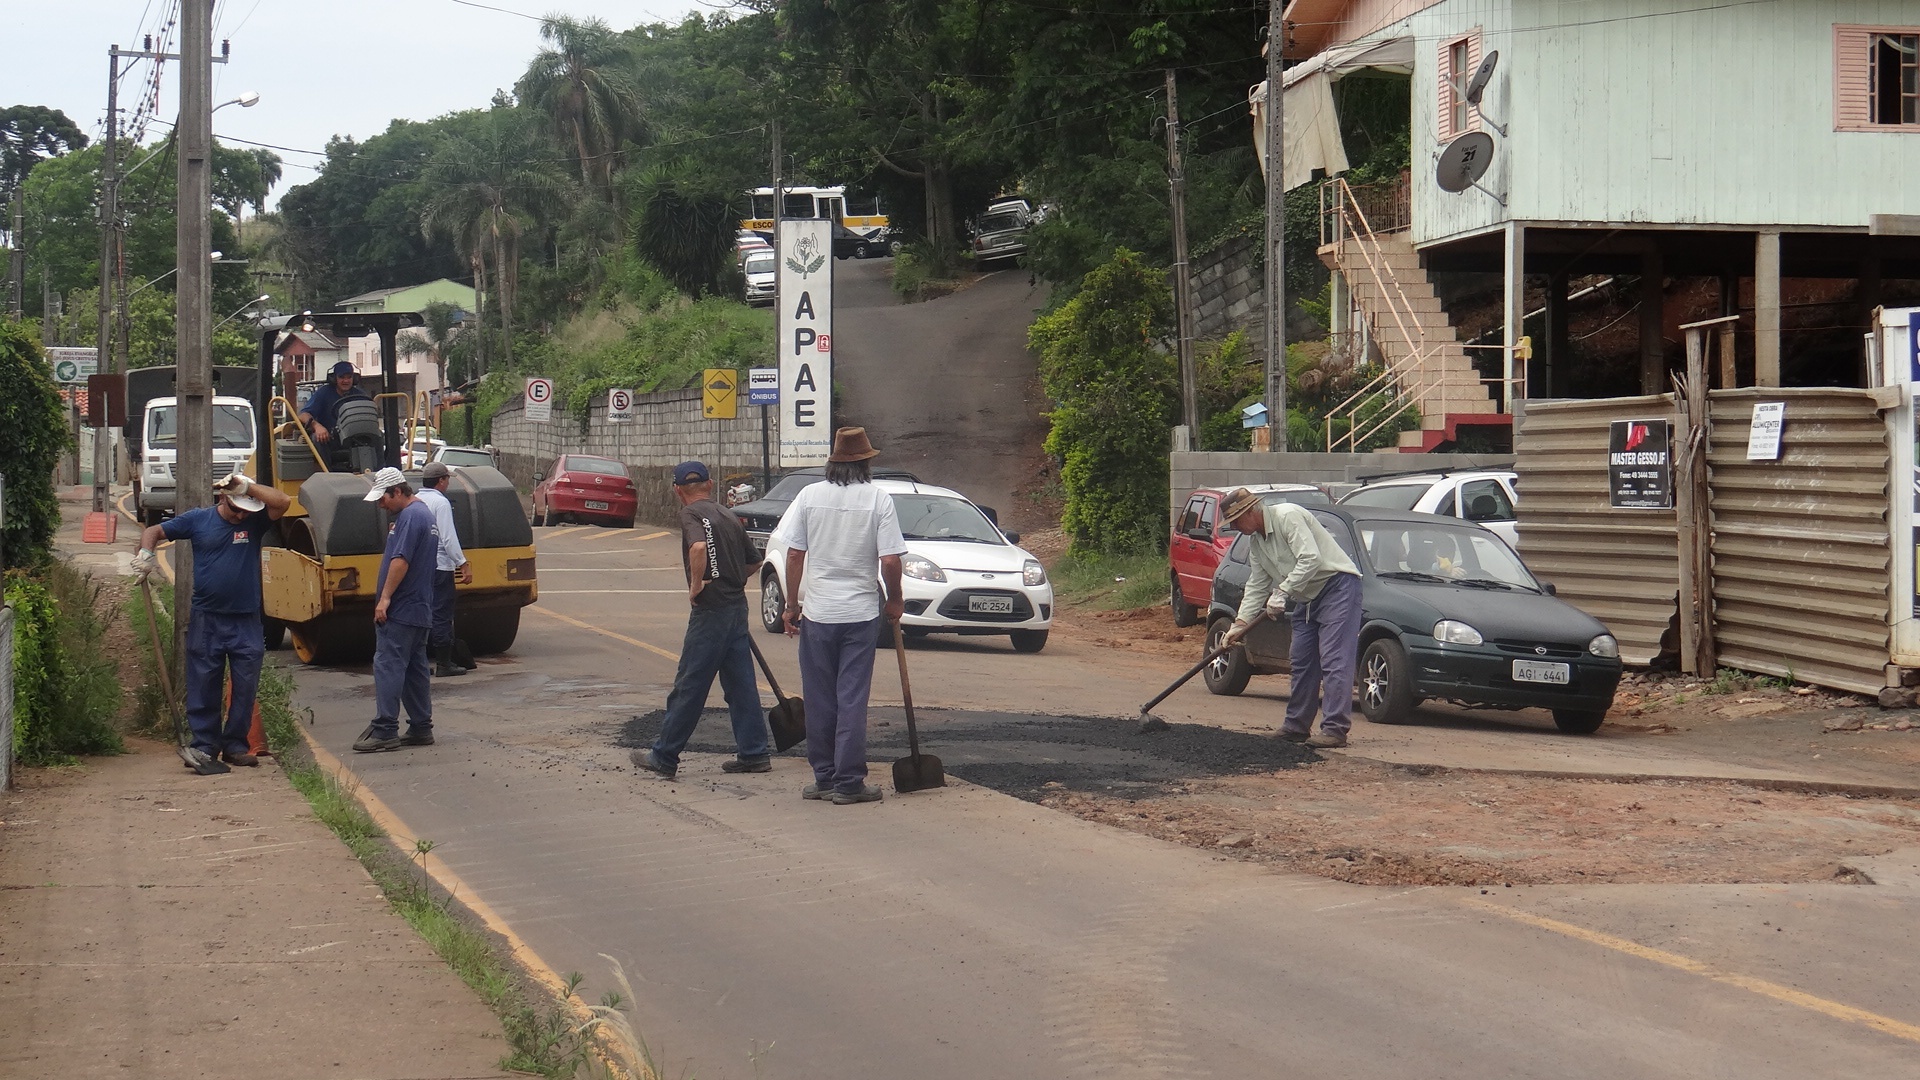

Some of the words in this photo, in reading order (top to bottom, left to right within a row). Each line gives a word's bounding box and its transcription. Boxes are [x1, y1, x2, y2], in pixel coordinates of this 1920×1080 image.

[1461, 150, 1477, 163] 21
[794, 291, 816, 427] APAE
[534, 385, 543, 398] E
[1611, 452, 1637, 465] MASTER
[1637, 452, 1658, 465] GESSO
[971, 601, 987, 610] MKC
[990, 602, 1011, 611] 2524
[1543, 670, 1566, 682] 6441
